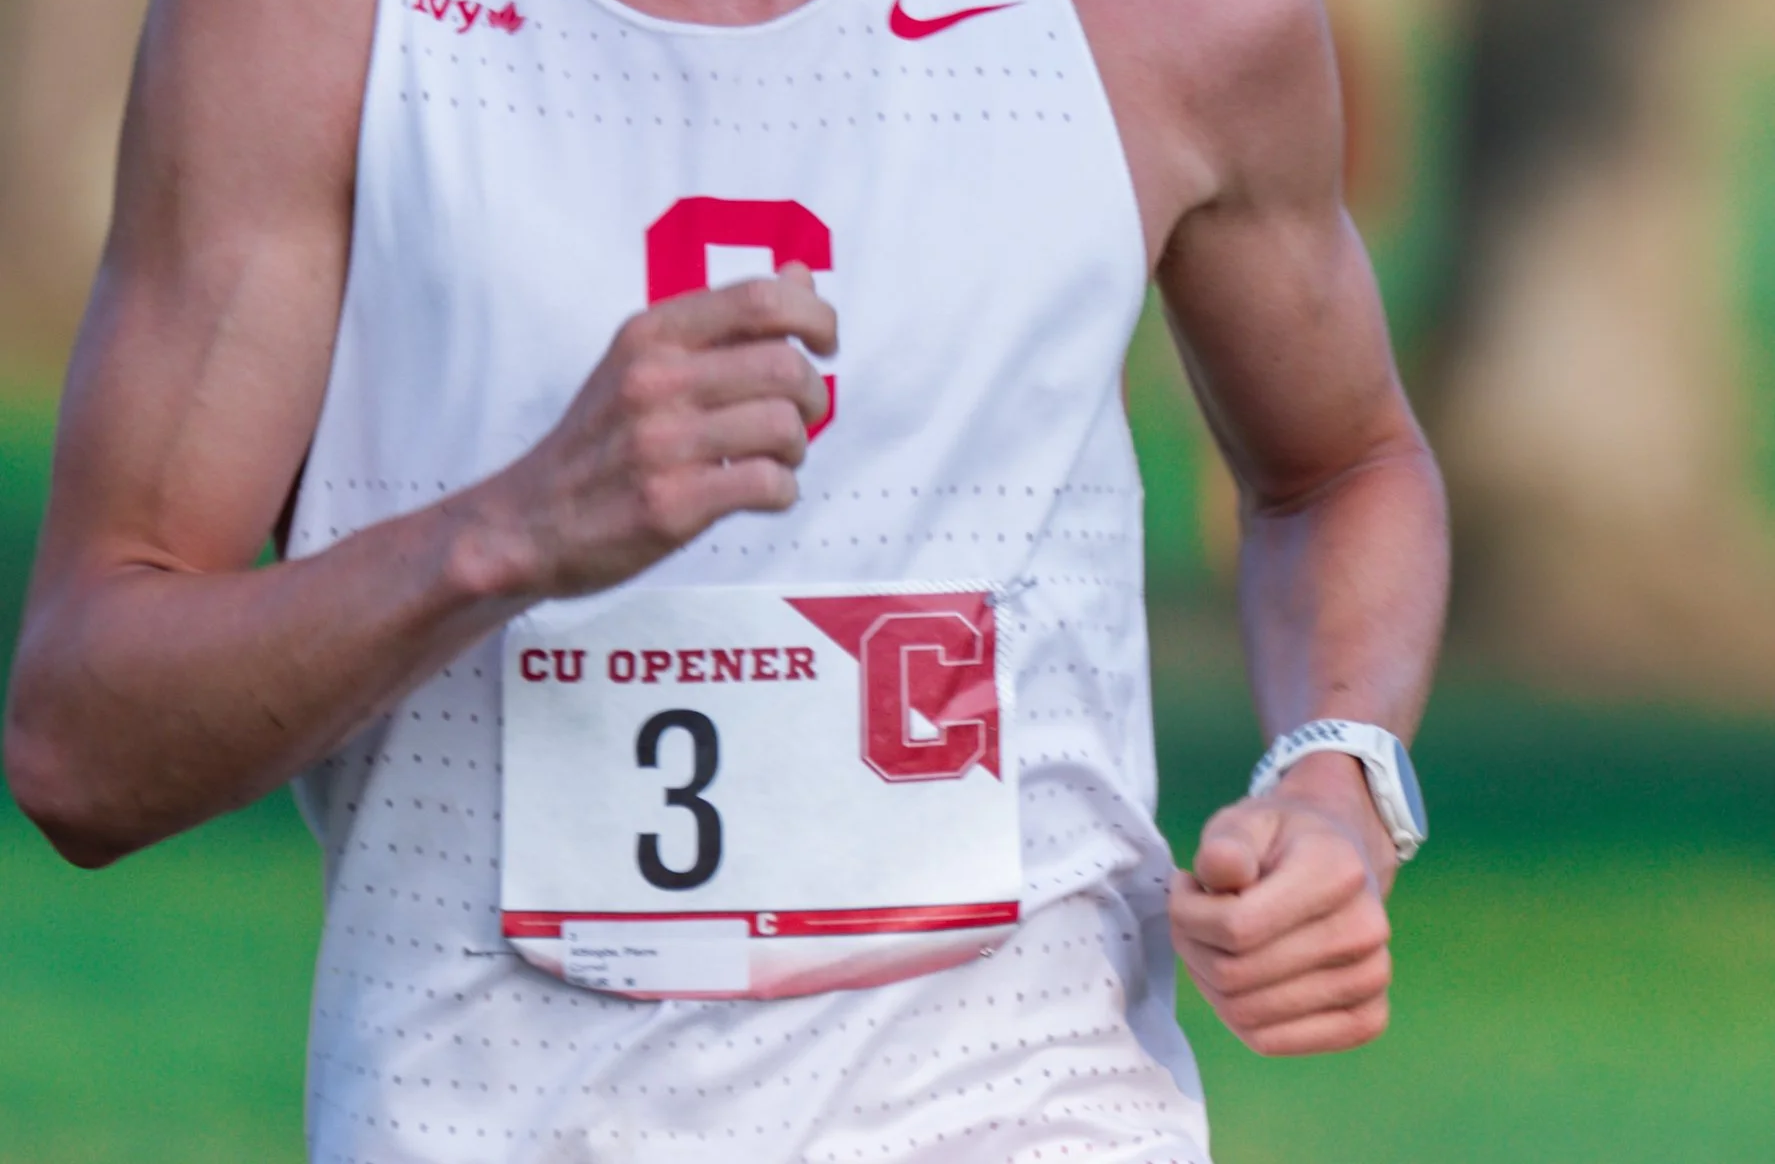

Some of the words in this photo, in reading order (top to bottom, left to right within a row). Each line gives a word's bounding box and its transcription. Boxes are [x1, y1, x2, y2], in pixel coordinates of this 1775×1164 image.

[519, 649, 586, 683] CU
[608, 646, 818, 683] OPENER
[860, 611, 987, 784] C
[634, 708, 723, 892] 3
[756, 912, 779, 935] C
